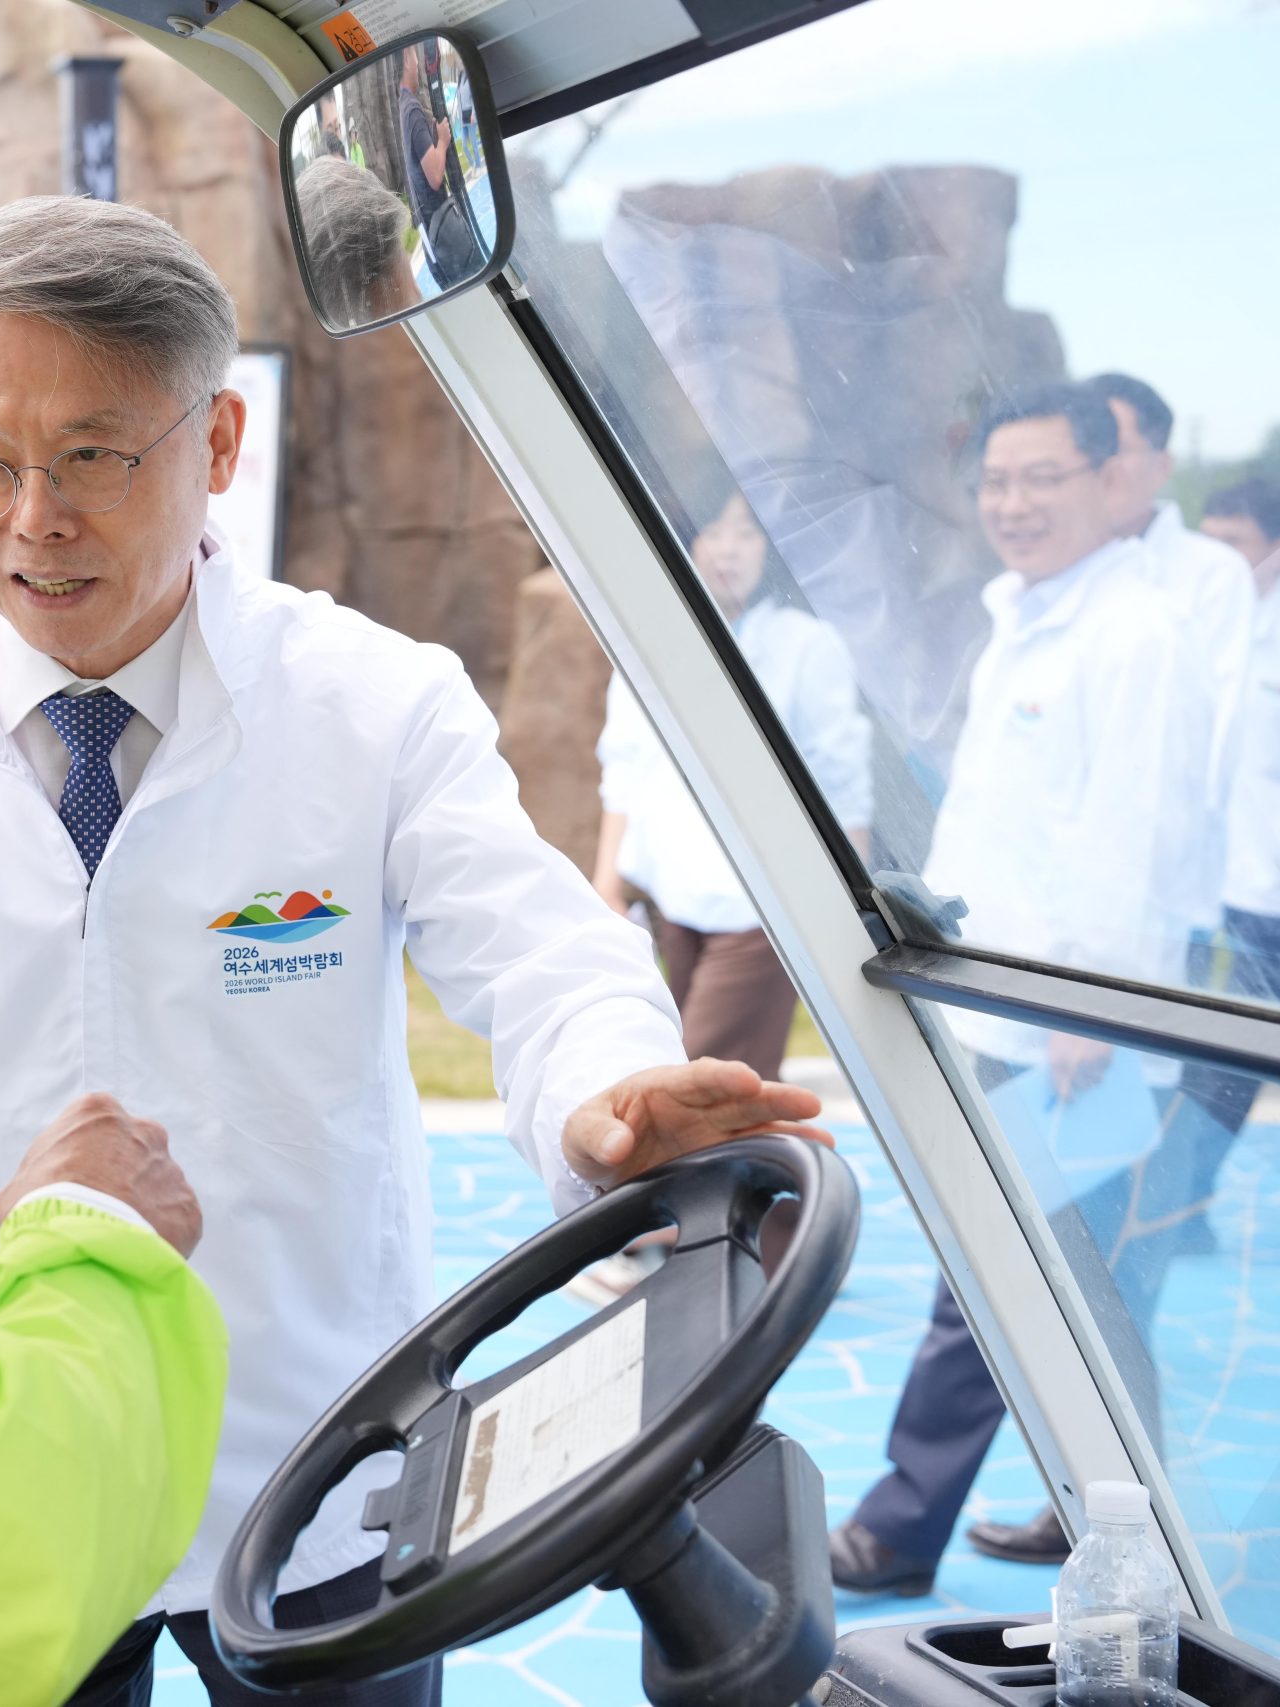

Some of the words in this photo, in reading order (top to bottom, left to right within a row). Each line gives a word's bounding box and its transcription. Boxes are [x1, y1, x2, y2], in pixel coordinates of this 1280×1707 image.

[344, 26, 371, 53] 경고
[224, 946, 259, 961] 2026
[223, 952, 343, 976] 여수세계섬박람회
[224, 979, 244, 988] 2026
[244, 977, 273, 986] WORLD
[275, 974, 303, 984] ISLAND
[304, 971, 322, 980] FAIR
[225, 987, 248, 996] YEOSU
[248, 986, 271, 994] KOREA
